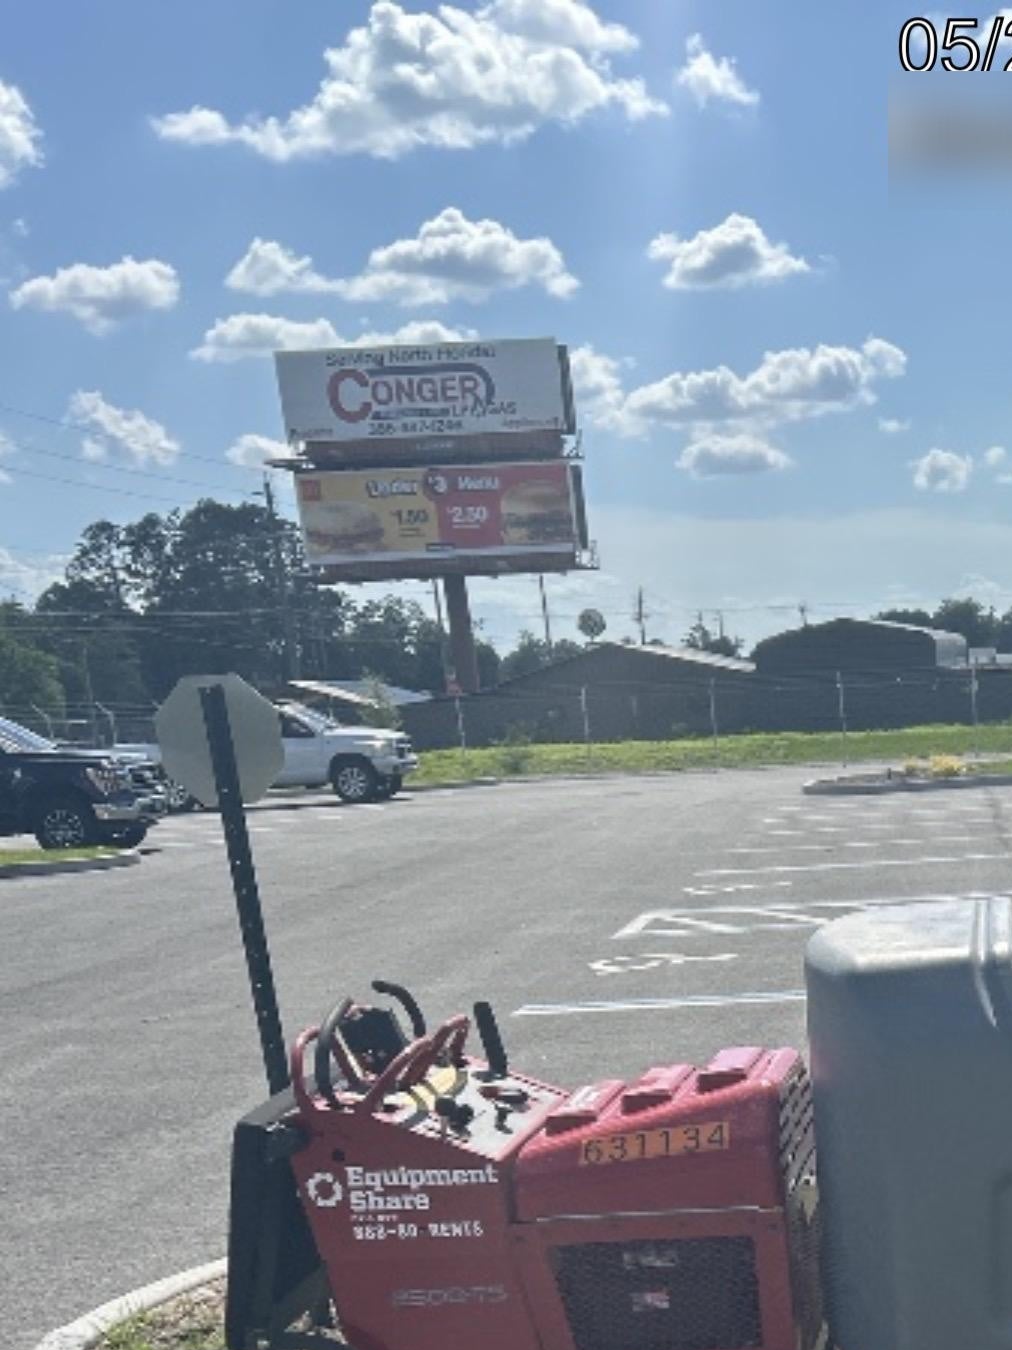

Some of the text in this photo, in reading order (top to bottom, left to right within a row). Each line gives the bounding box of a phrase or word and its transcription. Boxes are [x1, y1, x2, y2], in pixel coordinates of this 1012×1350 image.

[327, 368, 482, 424] CONGER
[584, 1123, 725, 1163] 631134
[344, 1164, 499, 1191] Equipment
[350, 1190, 430, 1210] Share
